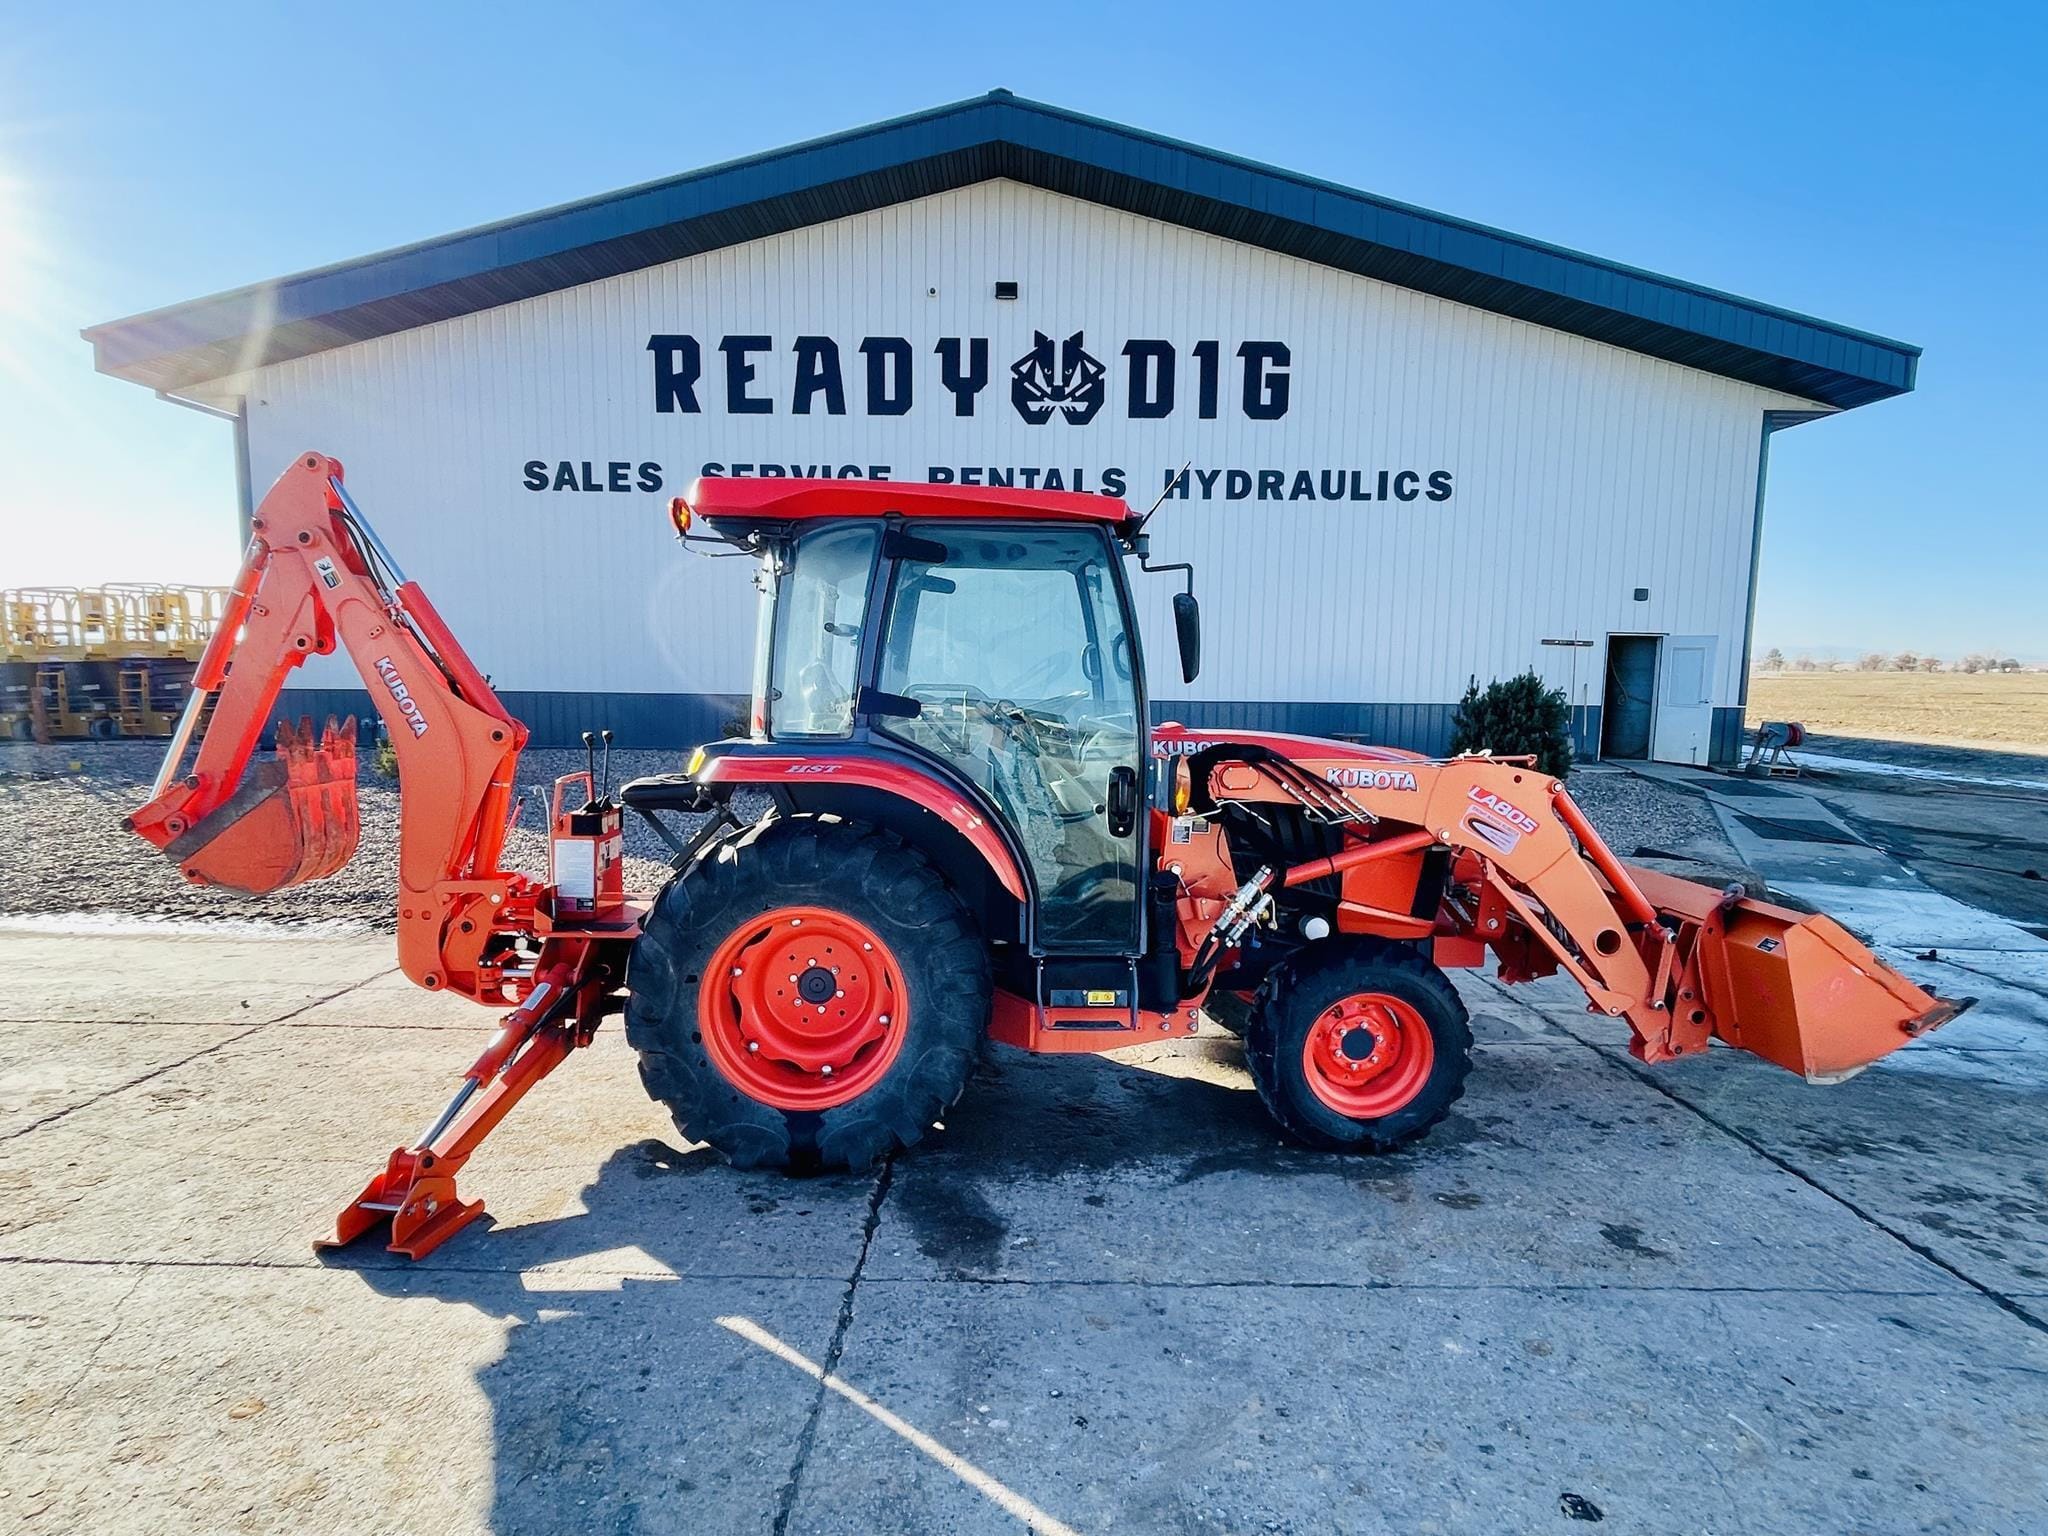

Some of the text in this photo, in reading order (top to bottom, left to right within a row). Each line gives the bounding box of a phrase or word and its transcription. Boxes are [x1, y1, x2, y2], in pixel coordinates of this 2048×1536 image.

[646, 334, 1291, 420] READY DIG
[523, 460, 663, 493] SALES
[1164, 469, 1453, 501] HYDRAULICS
[374, 656, 429, 739] KUBOTA
[785, 764, 843, 774] HST
[1326, 768, 1418, 792] KUBOTA
[1467, 786, 1538, 833] LA805
